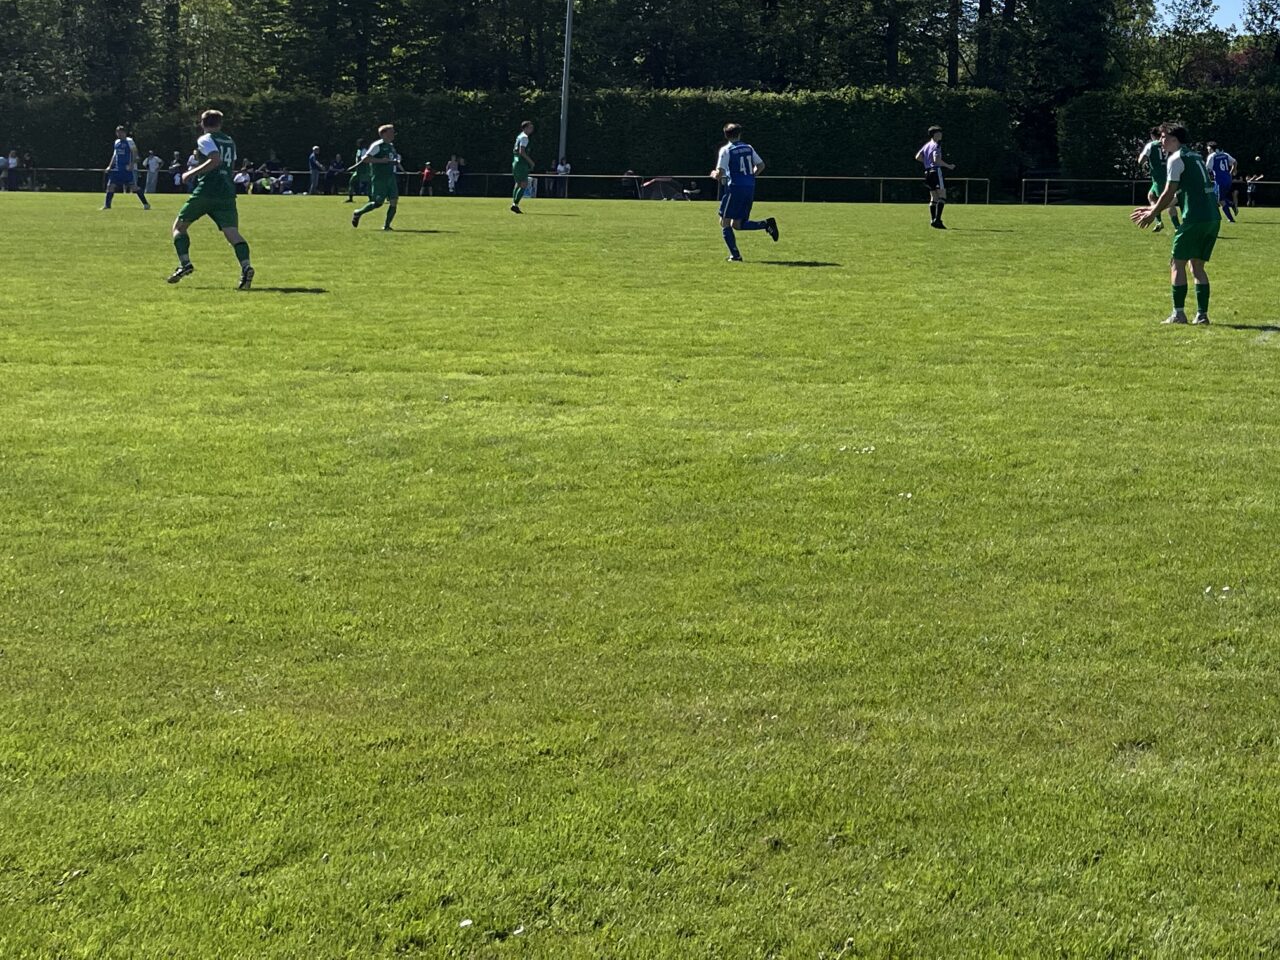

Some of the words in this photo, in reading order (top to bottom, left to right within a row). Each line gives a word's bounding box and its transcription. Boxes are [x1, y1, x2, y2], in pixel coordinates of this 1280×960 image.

[219, 145, 232, 167] 14
[740, 155, 753, 176] 41
[1219, 159, 1229, 171] 61
